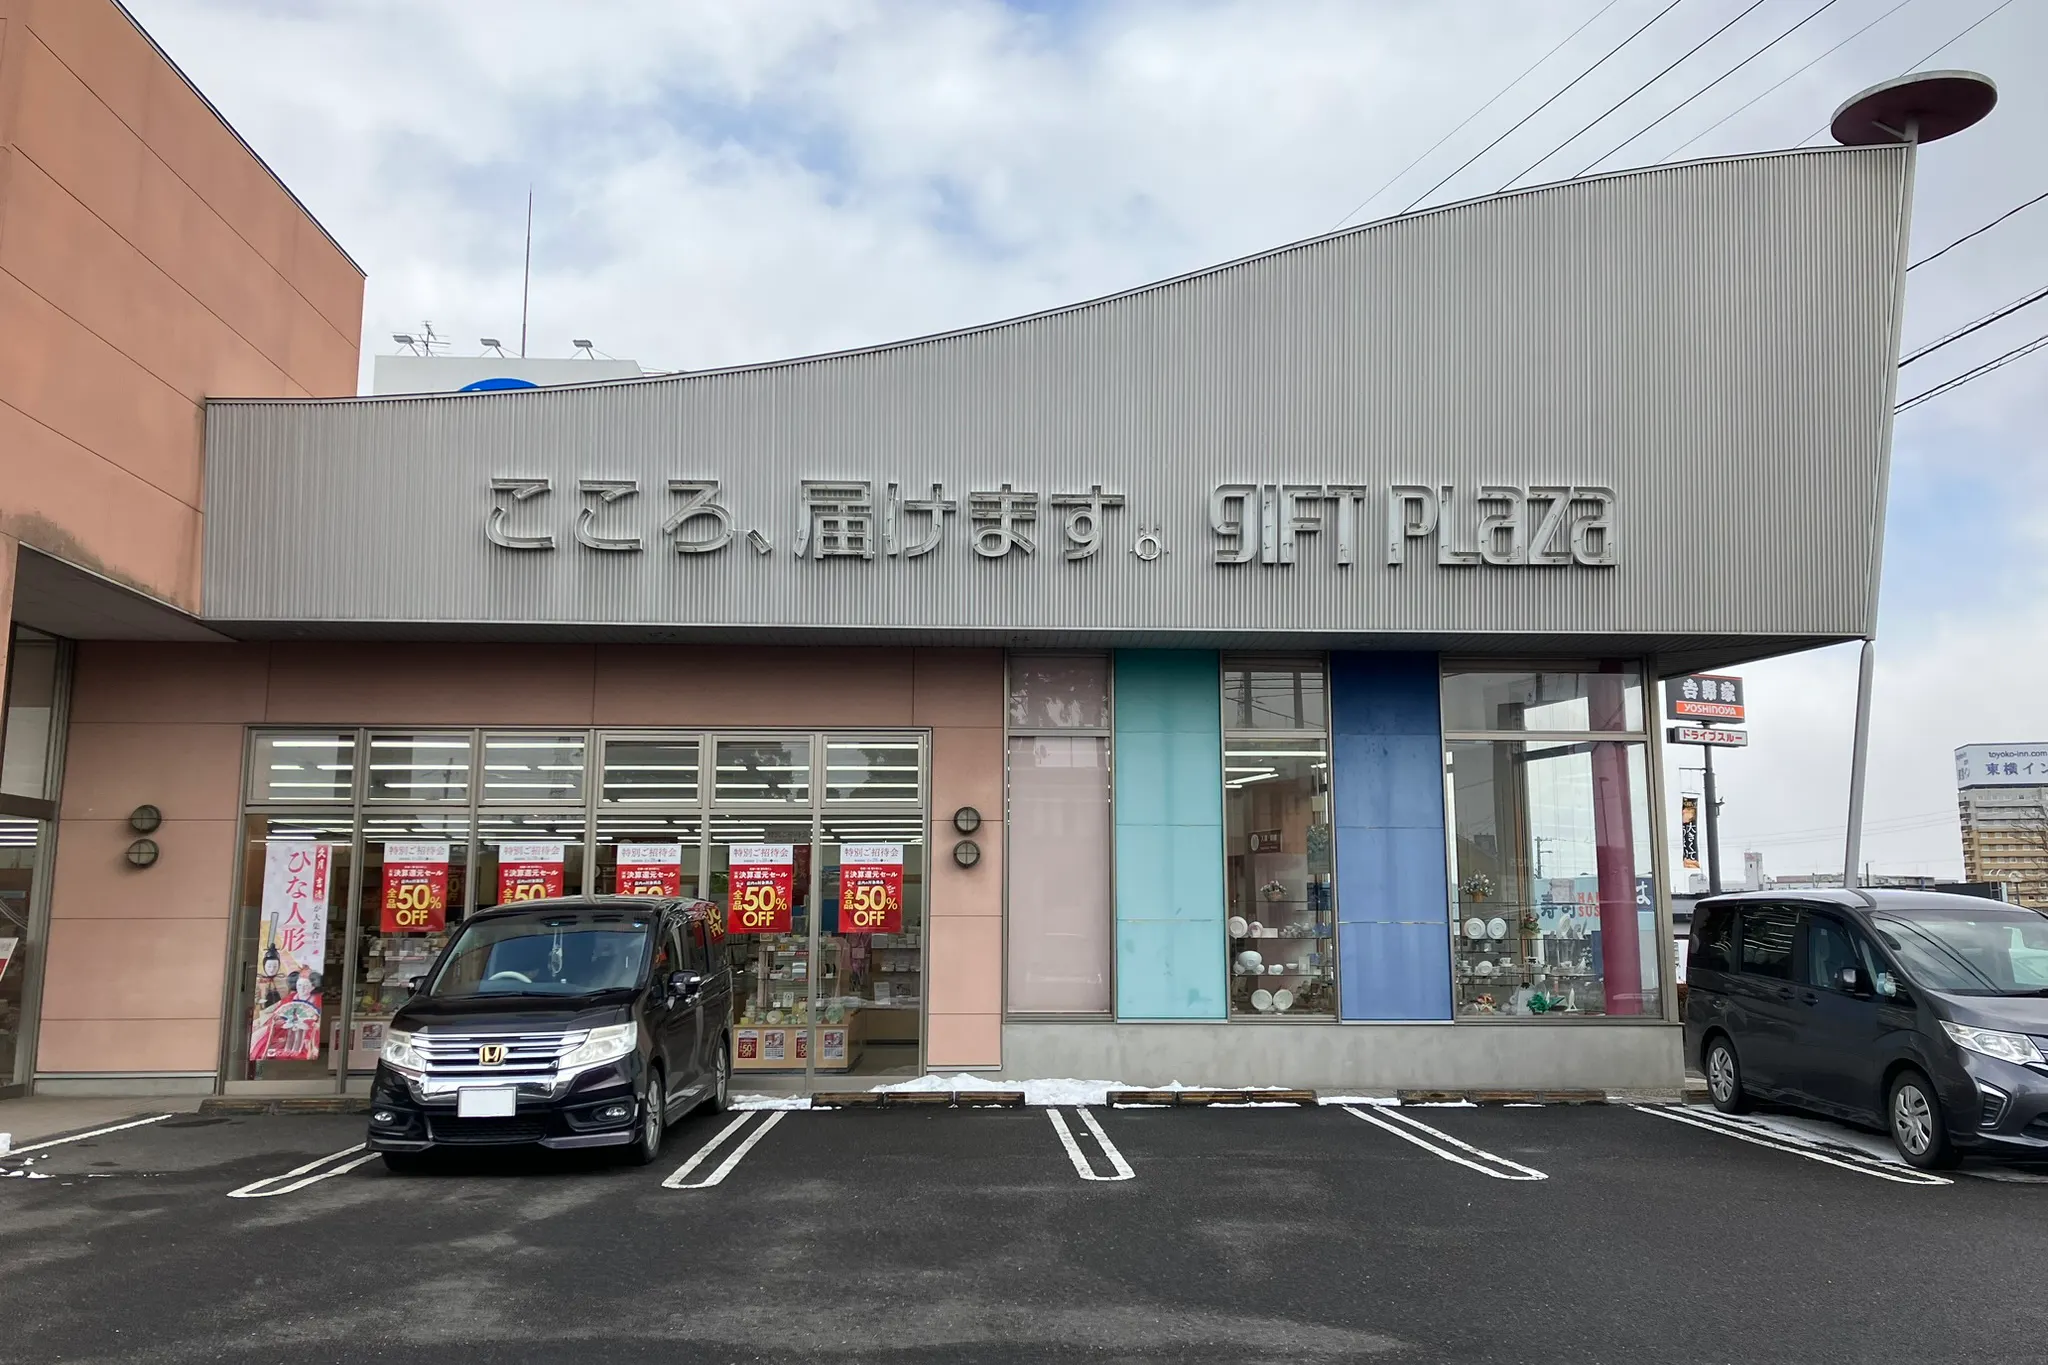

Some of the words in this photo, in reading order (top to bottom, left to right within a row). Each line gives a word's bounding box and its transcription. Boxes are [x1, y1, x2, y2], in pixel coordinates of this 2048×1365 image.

[486, 478, 1162, 561] こころ、届けます。
[1683, 730, 1743, 742] ドライブスルー
[281, 850, 311, 952] ひな人形
[387, 888, 397, 909] 全品
[397, 884, 442, 910] 50%
[733, 890, 743, 910] 全品
[743, 886, 787, 911] 50%
[844, 889, 854, 910] 全品
[854, 886, 897, 911] 50%
[396, 910, 428, 925] OFF
[743, 911, 774, 927] OFF
[854, 911, 885, 926] OFF
